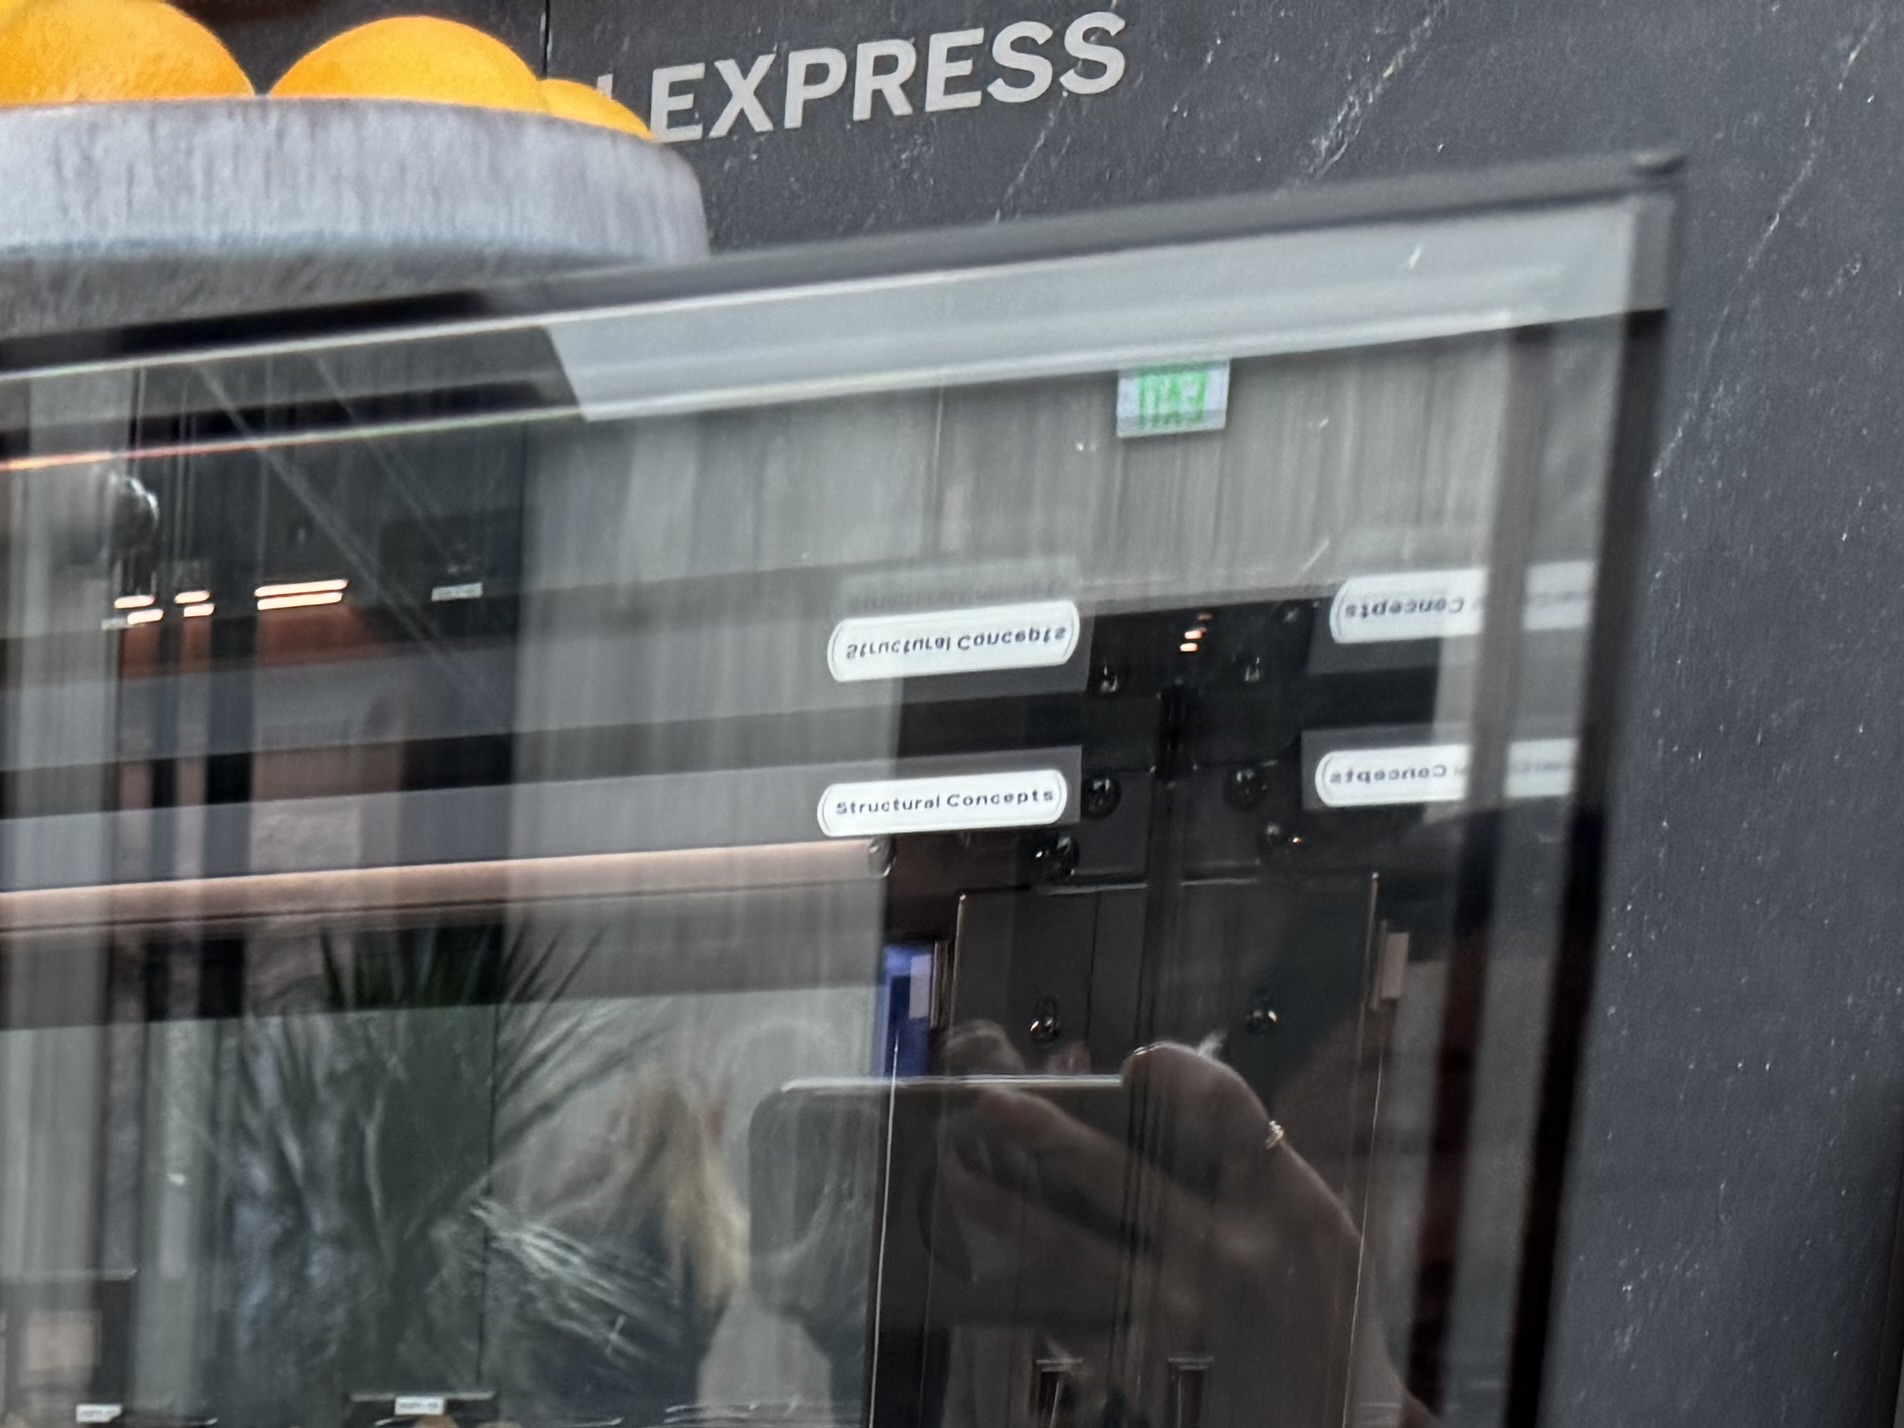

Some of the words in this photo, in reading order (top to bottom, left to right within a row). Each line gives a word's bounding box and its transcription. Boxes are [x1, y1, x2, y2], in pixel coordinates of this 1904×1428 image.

[651, 11, 1125, 143] EXPRESS
[836, 796, 940, 815] Structural
[946, 789, 1053, 809] Concepts
